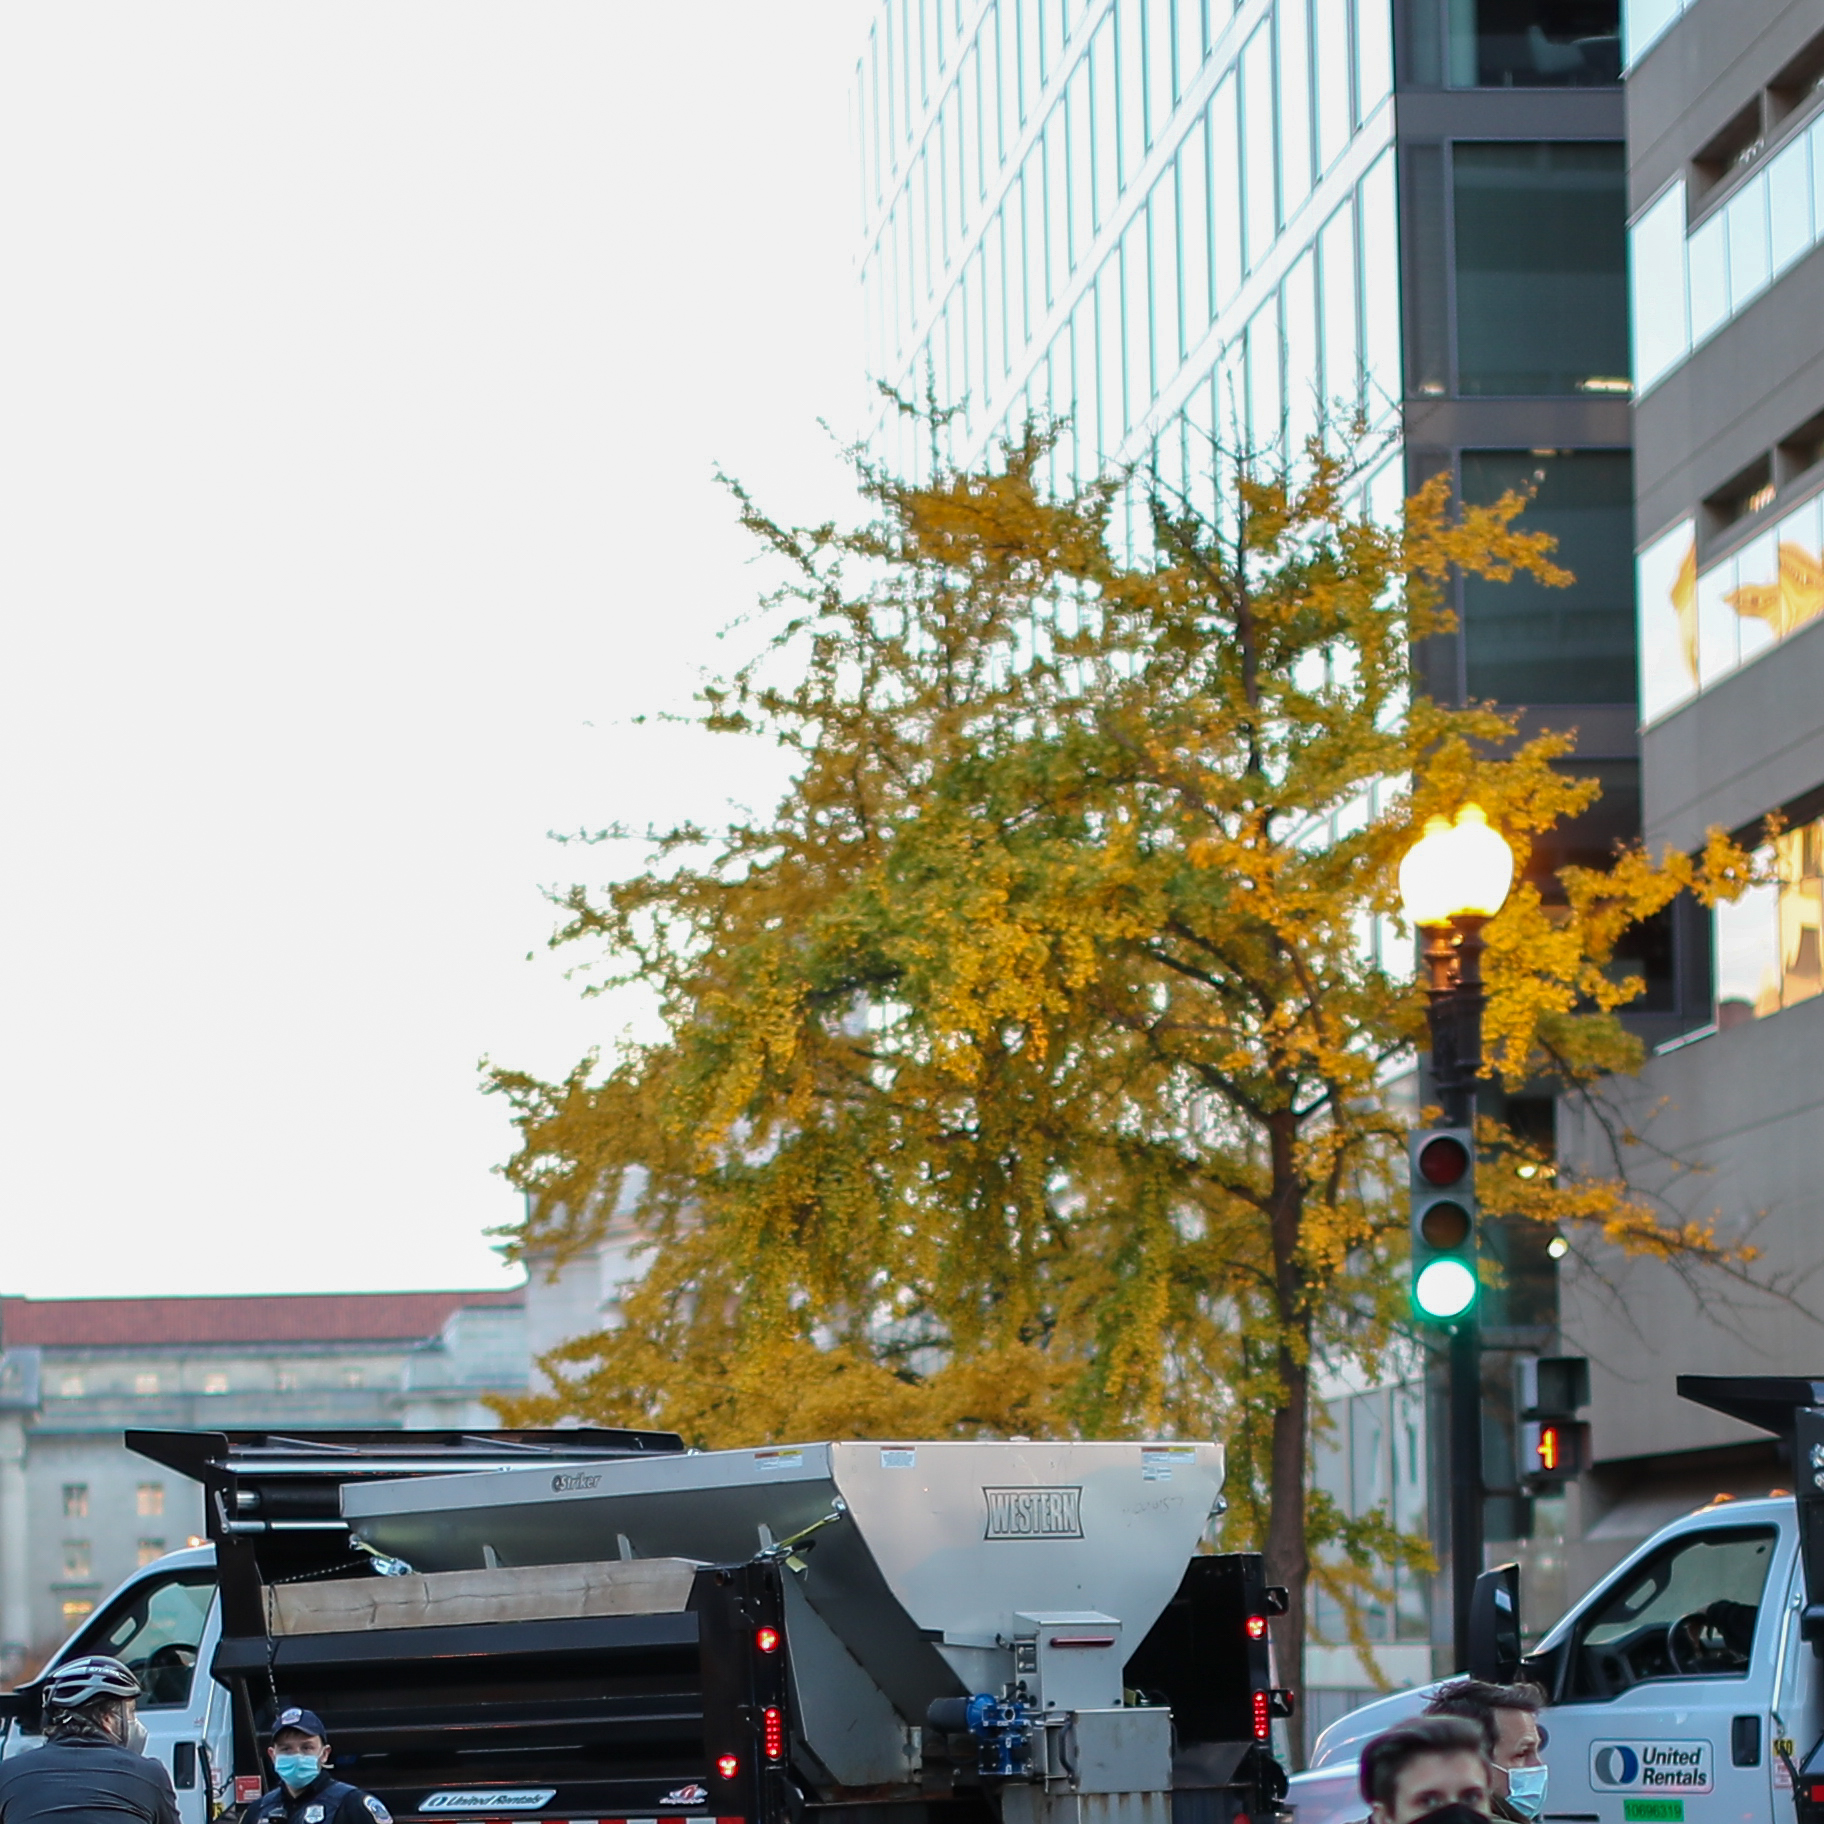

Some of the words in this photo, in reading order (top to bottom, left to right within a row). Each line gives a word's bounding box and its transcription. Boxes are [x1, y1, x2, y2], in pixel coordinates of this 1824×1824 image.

[991, 1492, 1076, 1534] WESTERN
[1643, 1746, 1702, 1765] United
[1642, 1767, 1707, 1786] Rentals
